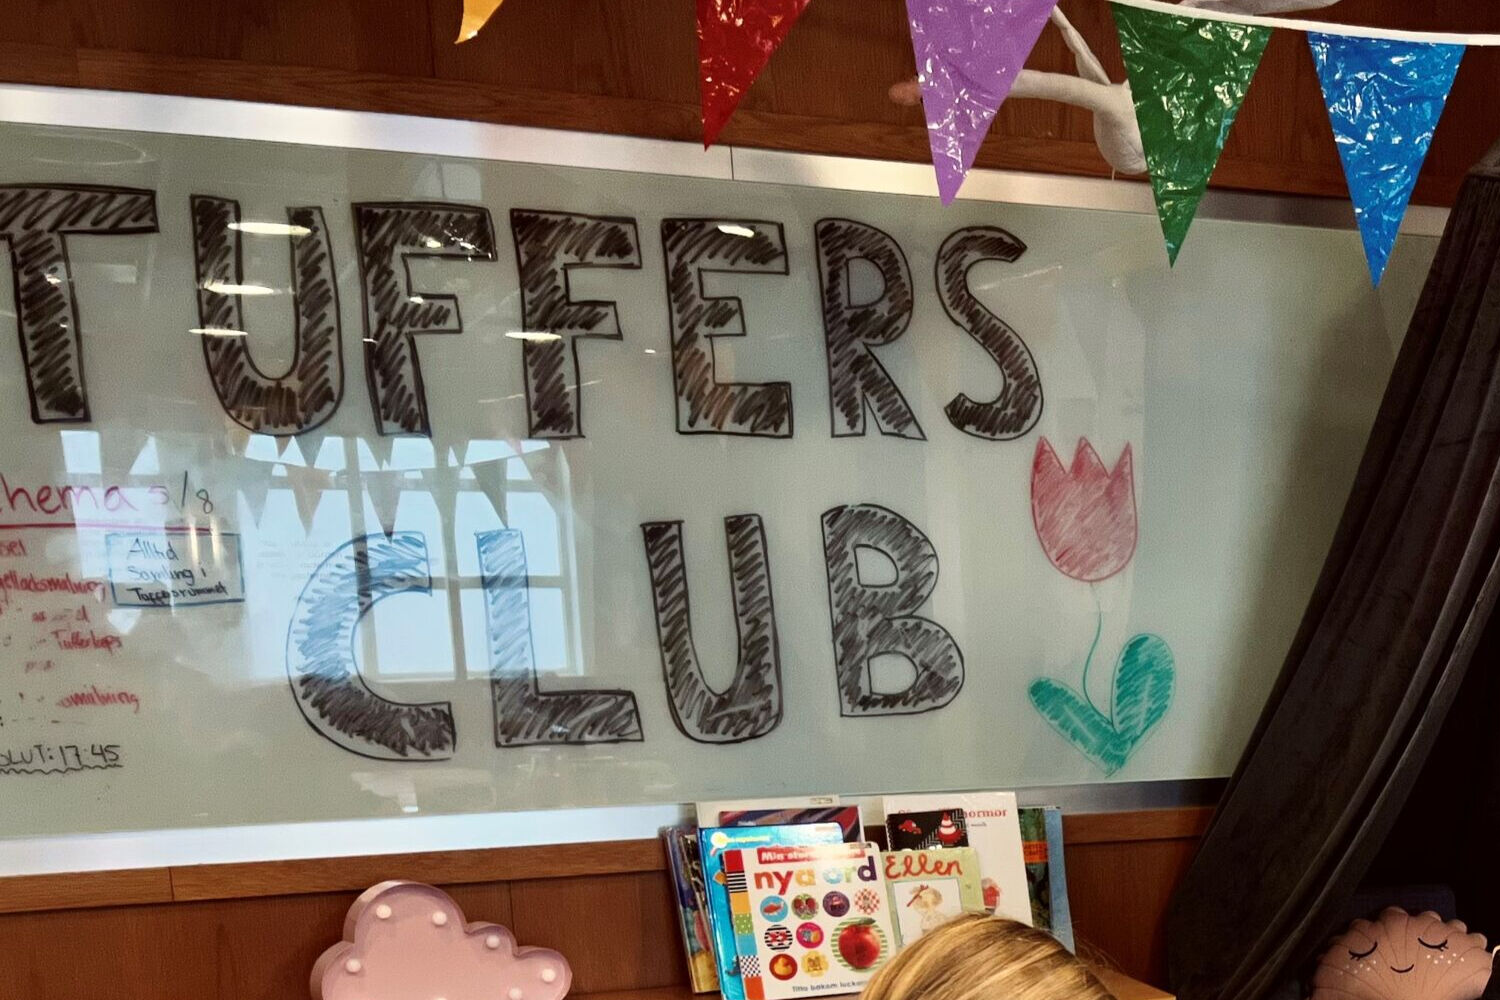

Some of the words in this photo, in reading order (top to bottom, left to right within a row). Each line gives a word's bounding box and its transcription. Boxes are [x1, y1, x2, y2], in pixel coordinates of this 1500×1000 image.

[0, 182, 1045, 442] TUFFERS
[0, 472, 139, 514] hema
[286, 504, 965, 762] CLUB
[754, 869, 816, 895] nya
[822, 855, 878, 885] ord
[885, 854, 963, 879] Ellen
